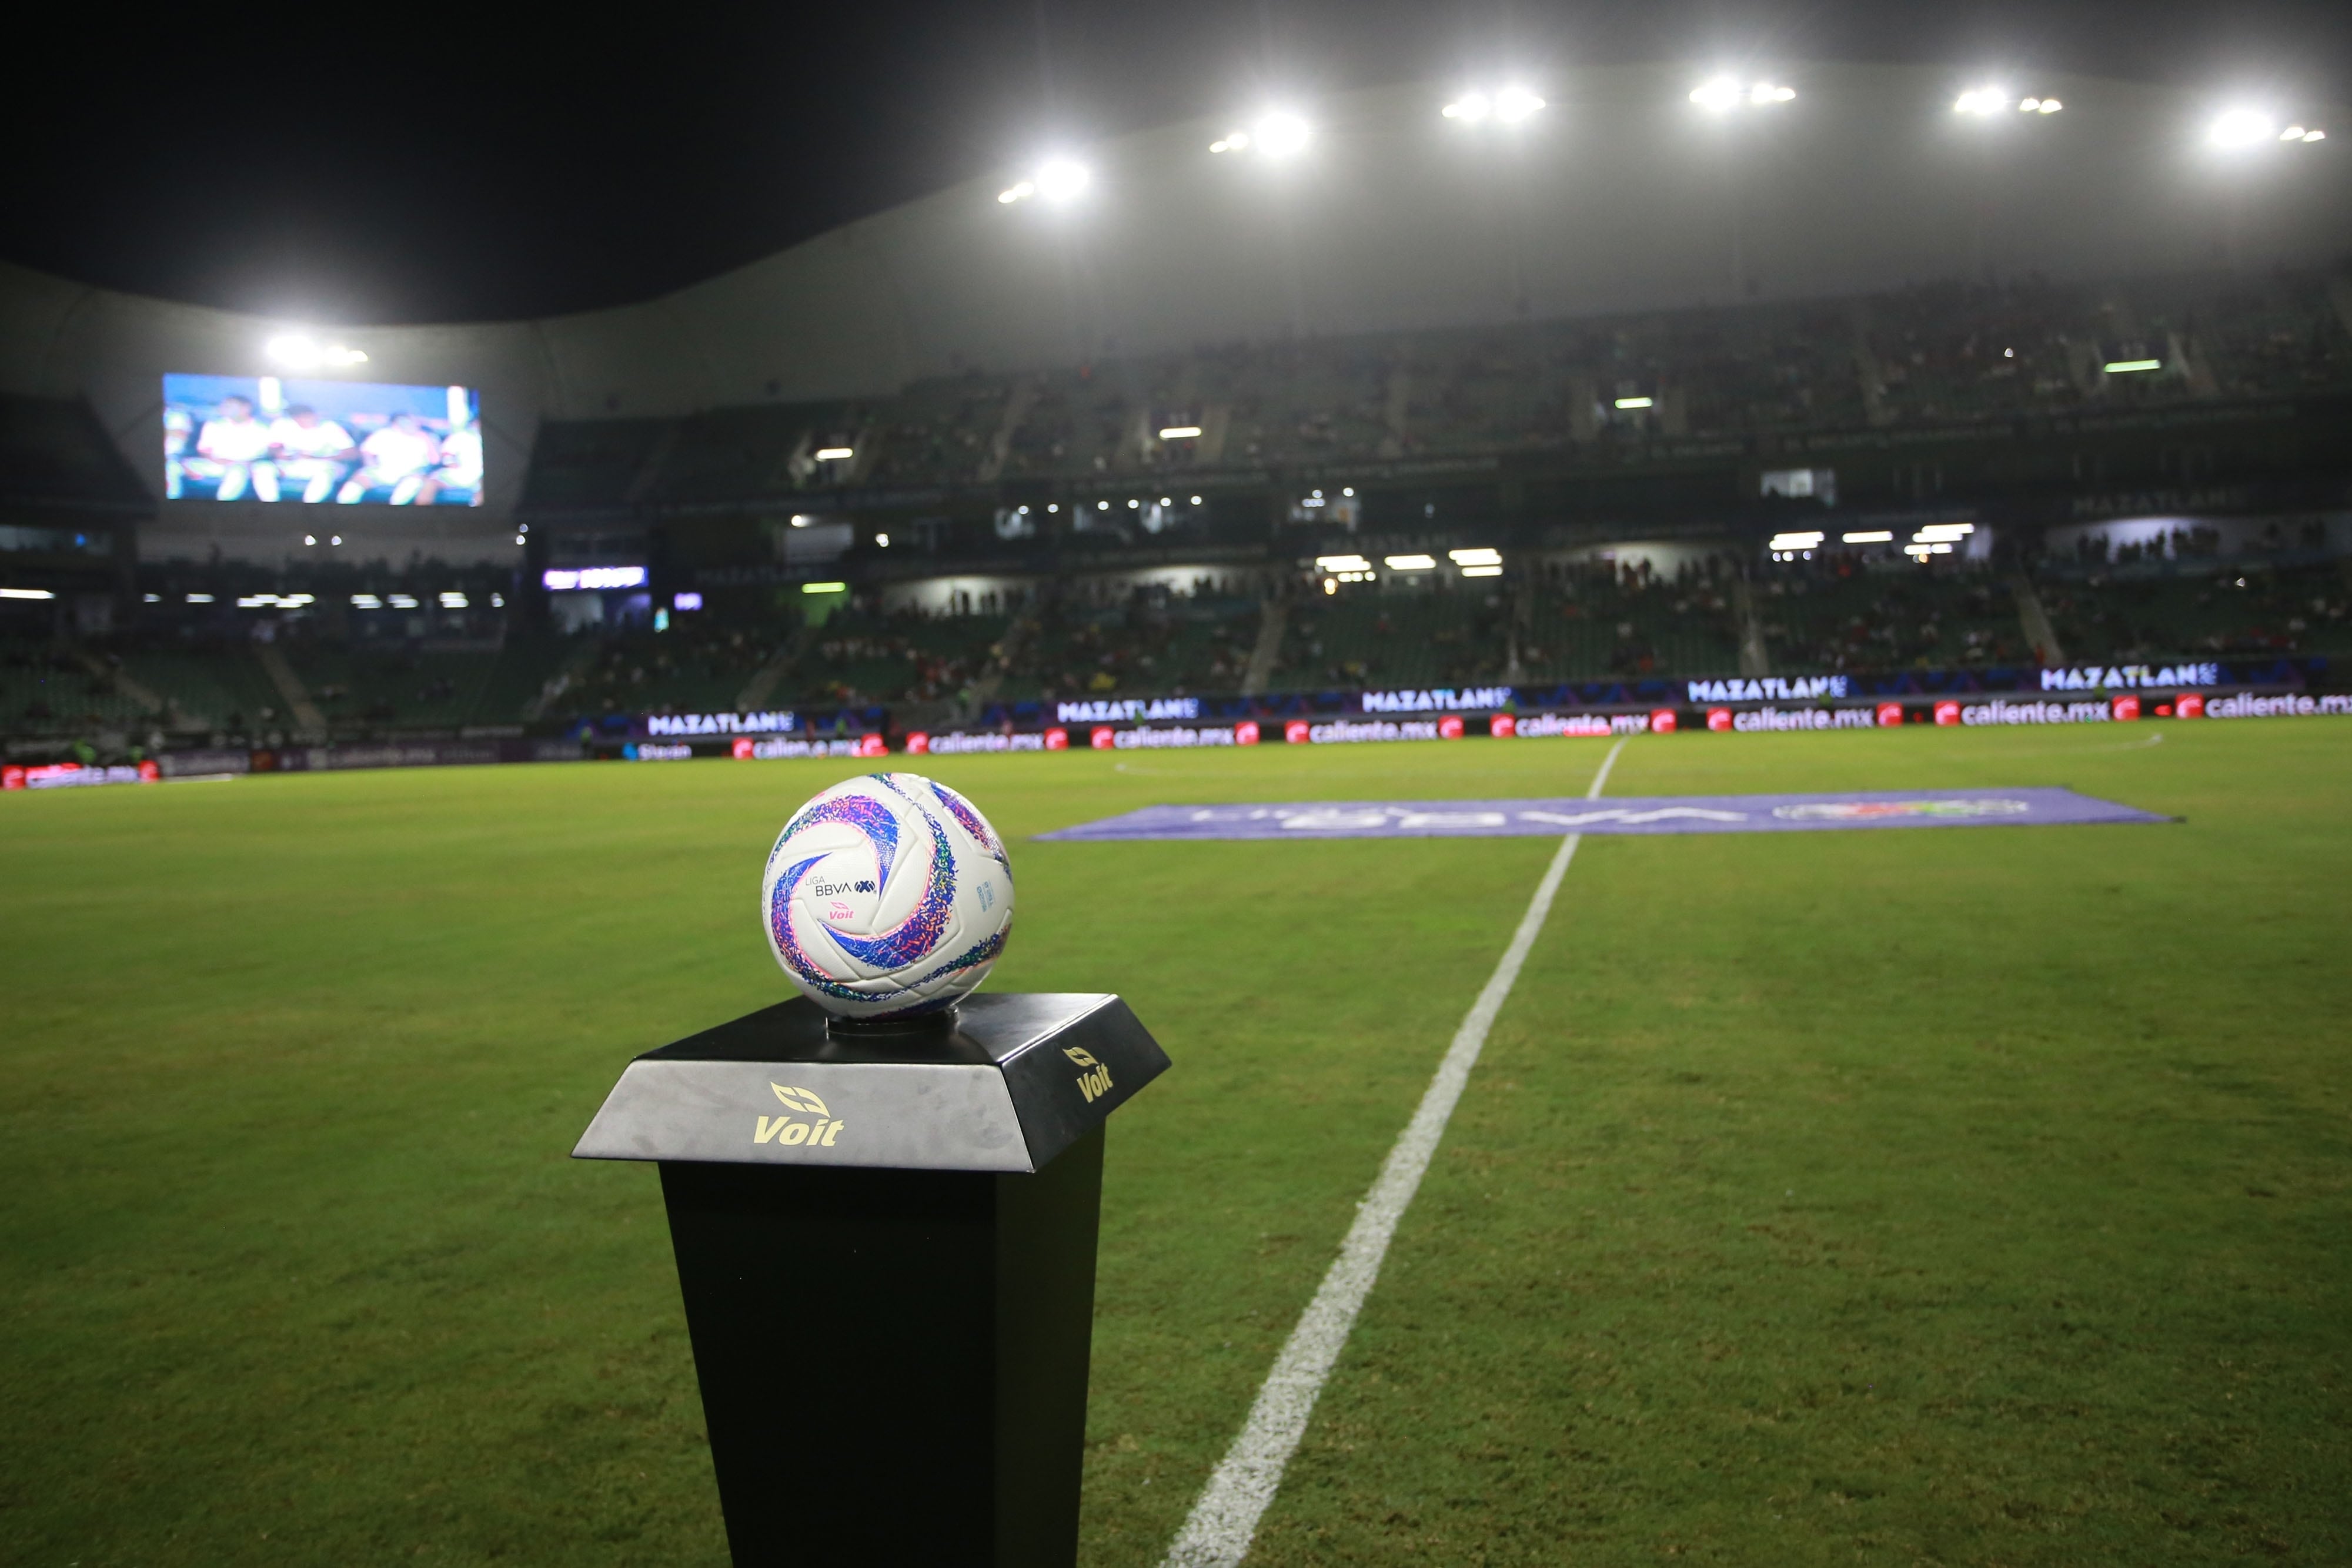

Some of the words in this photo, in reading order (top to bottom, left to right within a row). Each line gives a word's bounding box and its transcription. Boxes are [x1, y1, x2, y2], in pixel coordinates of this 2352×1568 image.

[1733, 707, 1874, 731] caliente.mx
[1961, 700, 2110, 726] caliente.mx
[805, 876, 826, 886] LIGA
[816, 882, 852, 897] BBVA
[829, 910, 854, 920] Voit
[1077, 1062, 1114, 1103] Voit
[753, 1115, 844, 1146] Voit
